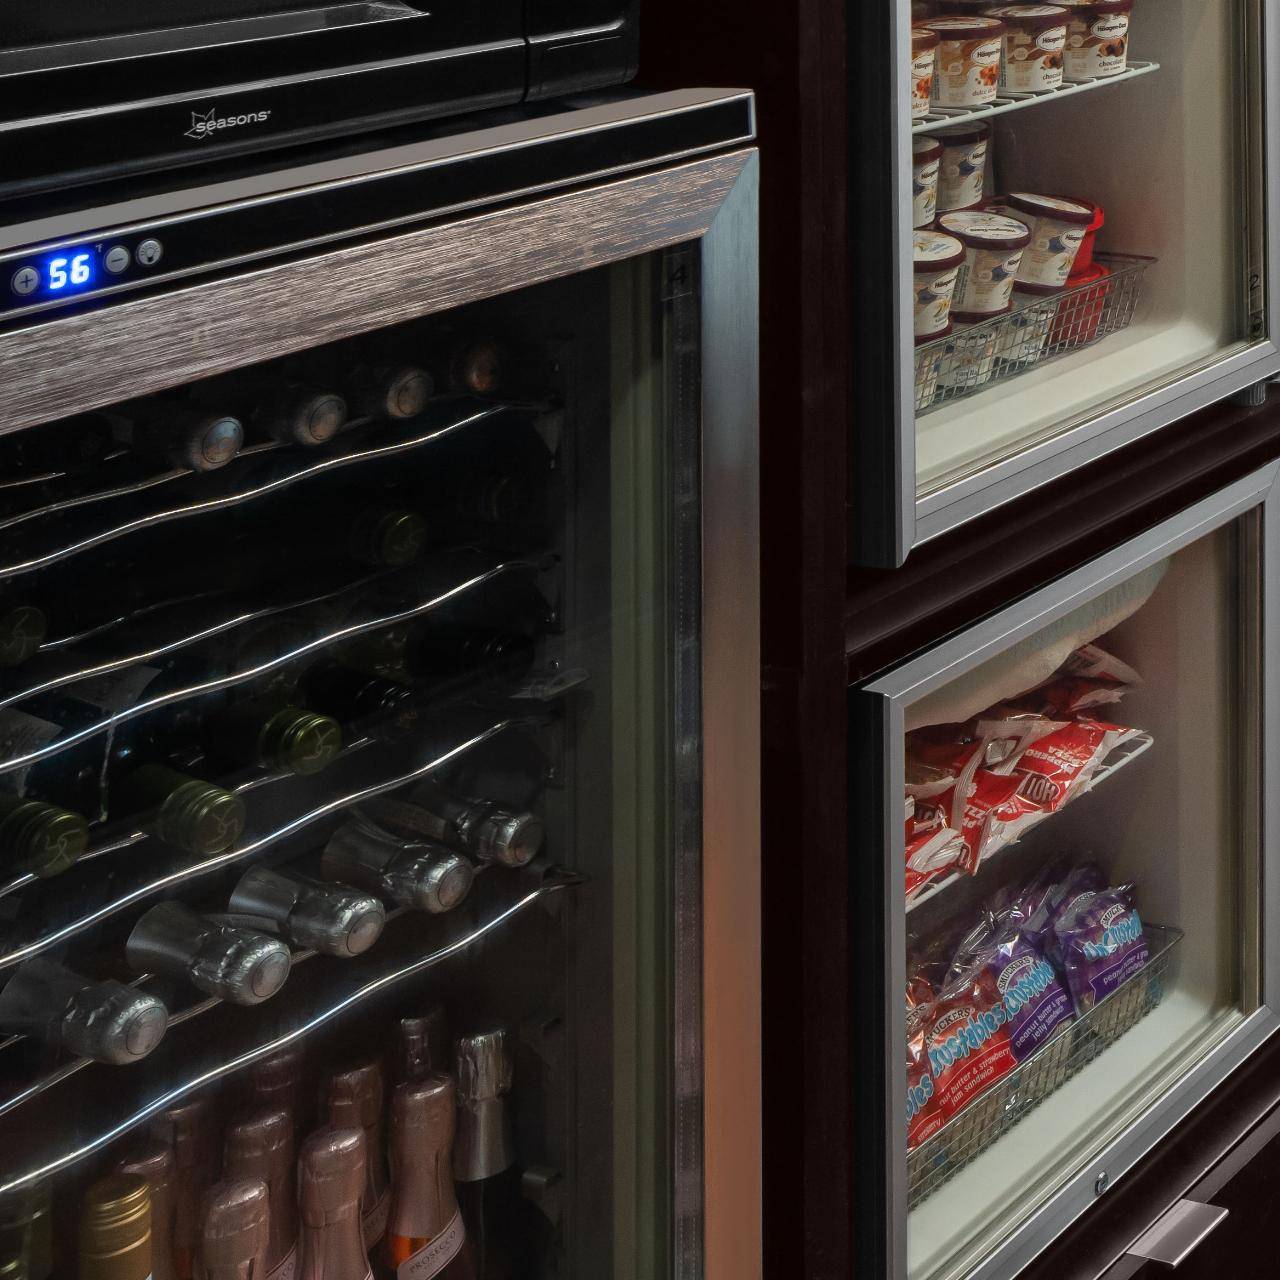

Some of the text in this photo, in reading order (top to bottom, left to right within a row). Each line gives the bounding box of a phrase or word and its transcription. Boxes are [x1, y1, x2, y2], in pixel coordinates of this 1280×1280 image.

[195, 109, 268, 133] seasons
[48, 253, 91, 290] 56
[950, 1072, 972, 1095] butter
